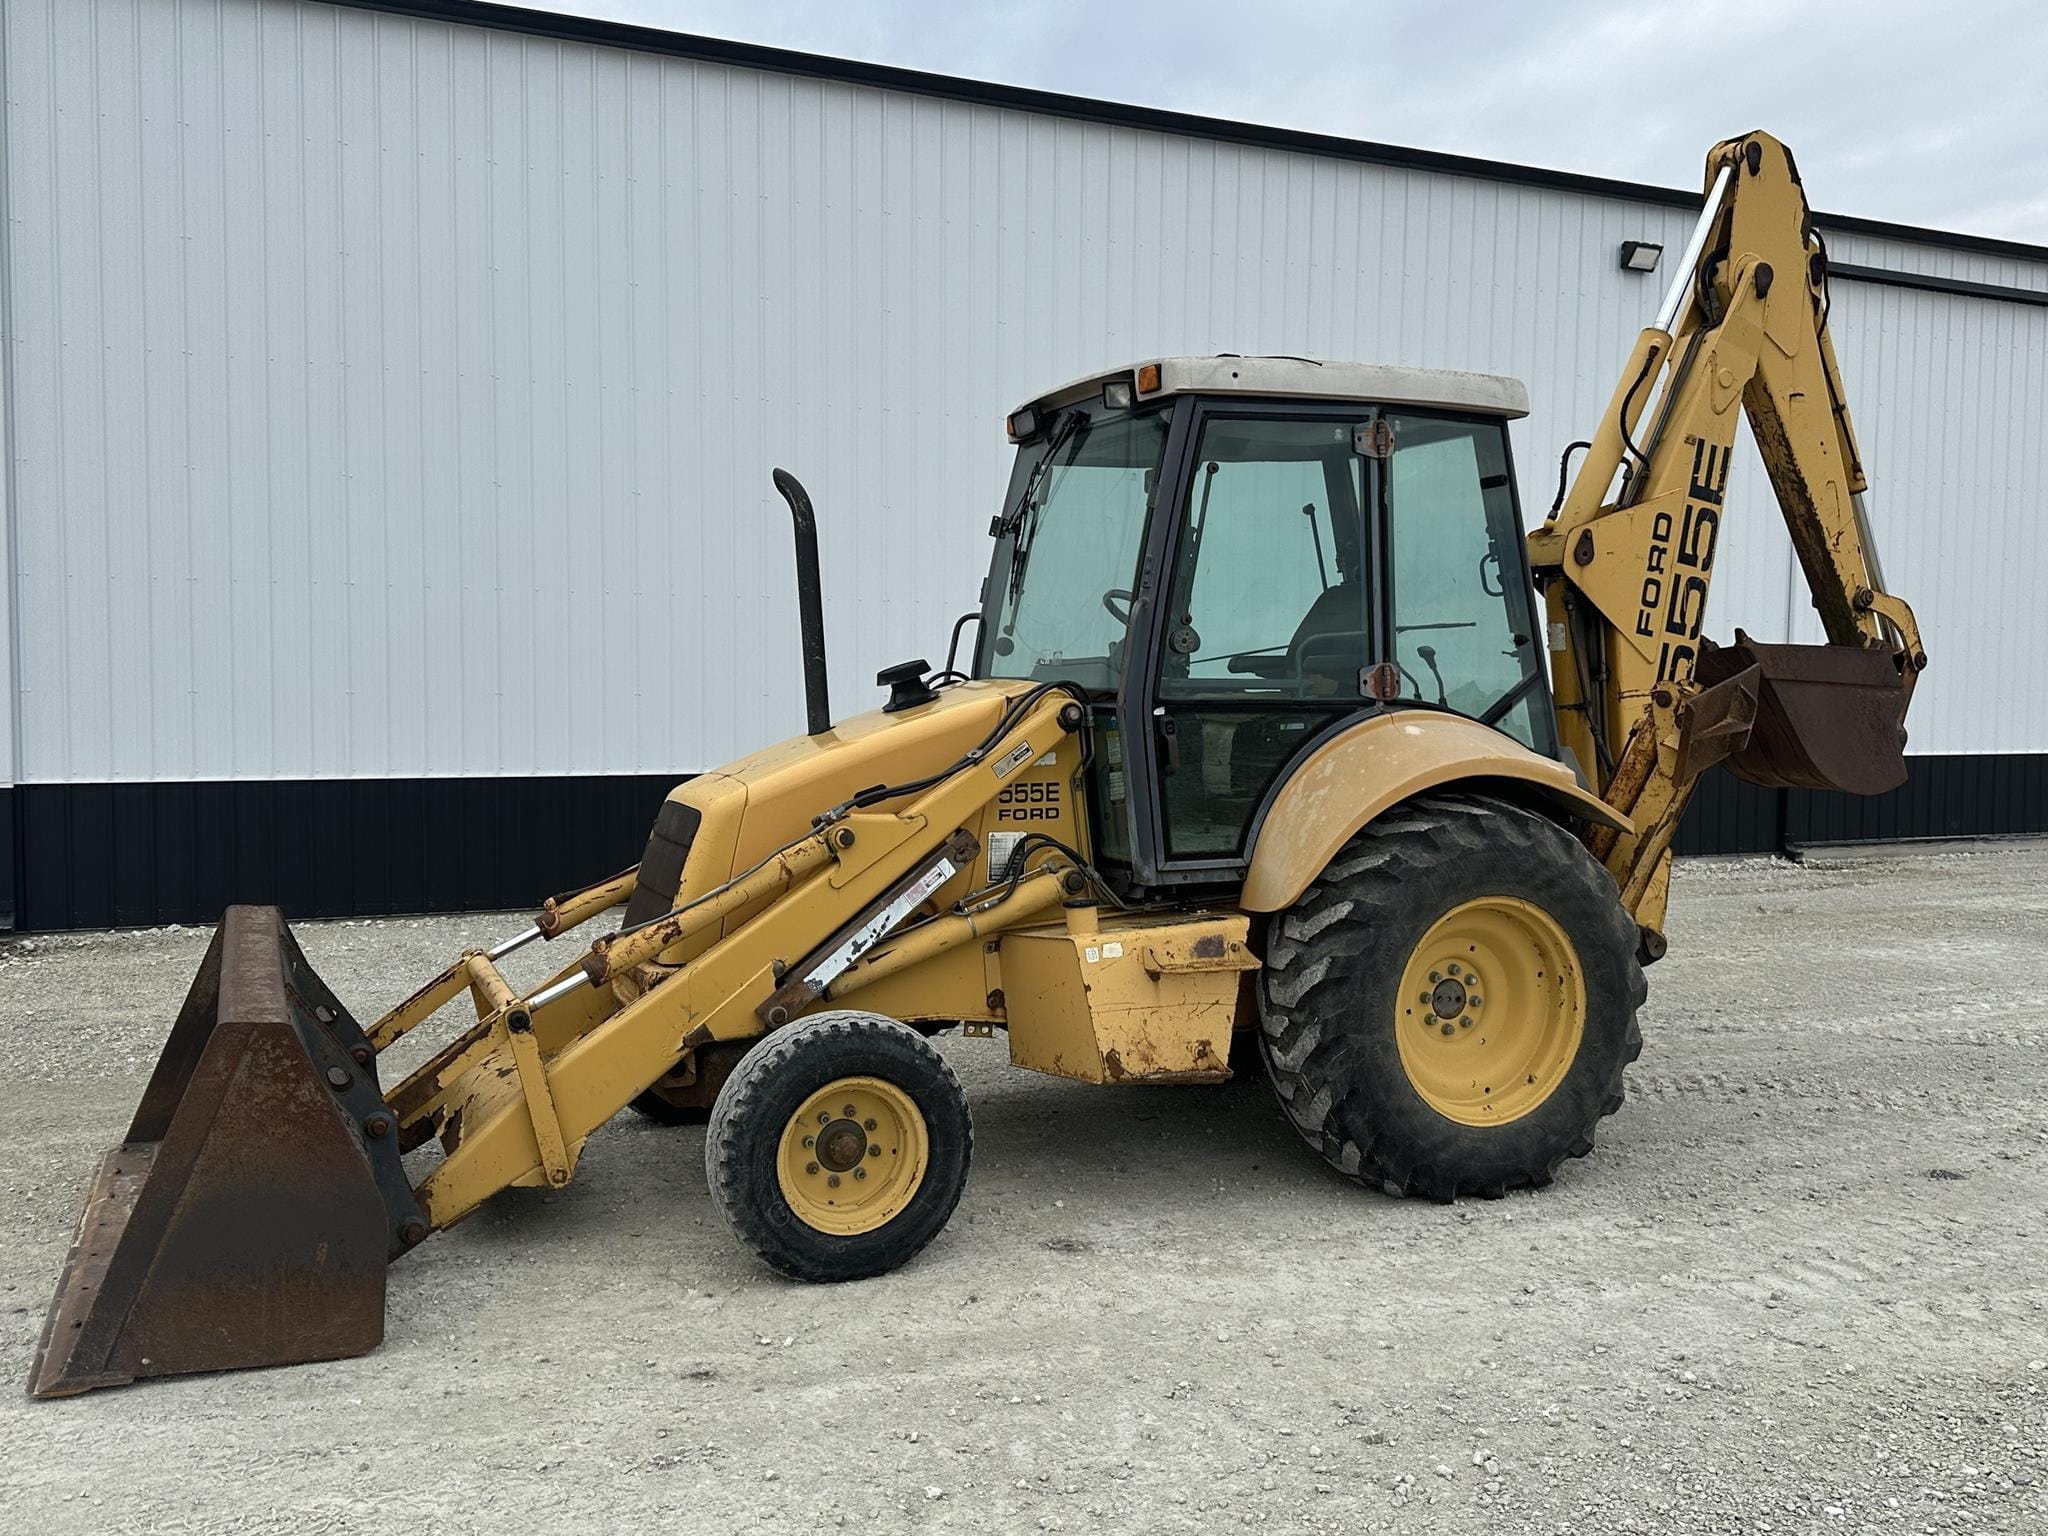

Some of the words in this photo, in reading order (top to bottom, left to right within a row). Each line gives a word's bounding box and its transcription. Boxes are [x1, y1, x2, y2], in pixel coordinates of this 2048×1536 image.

[1636, 512, 1673, 637] FORD
[1655, 437, 1732, 684] 555E
[998, 782, 1060, 804] 555E
[998, 807, 1060, 821] FORD
